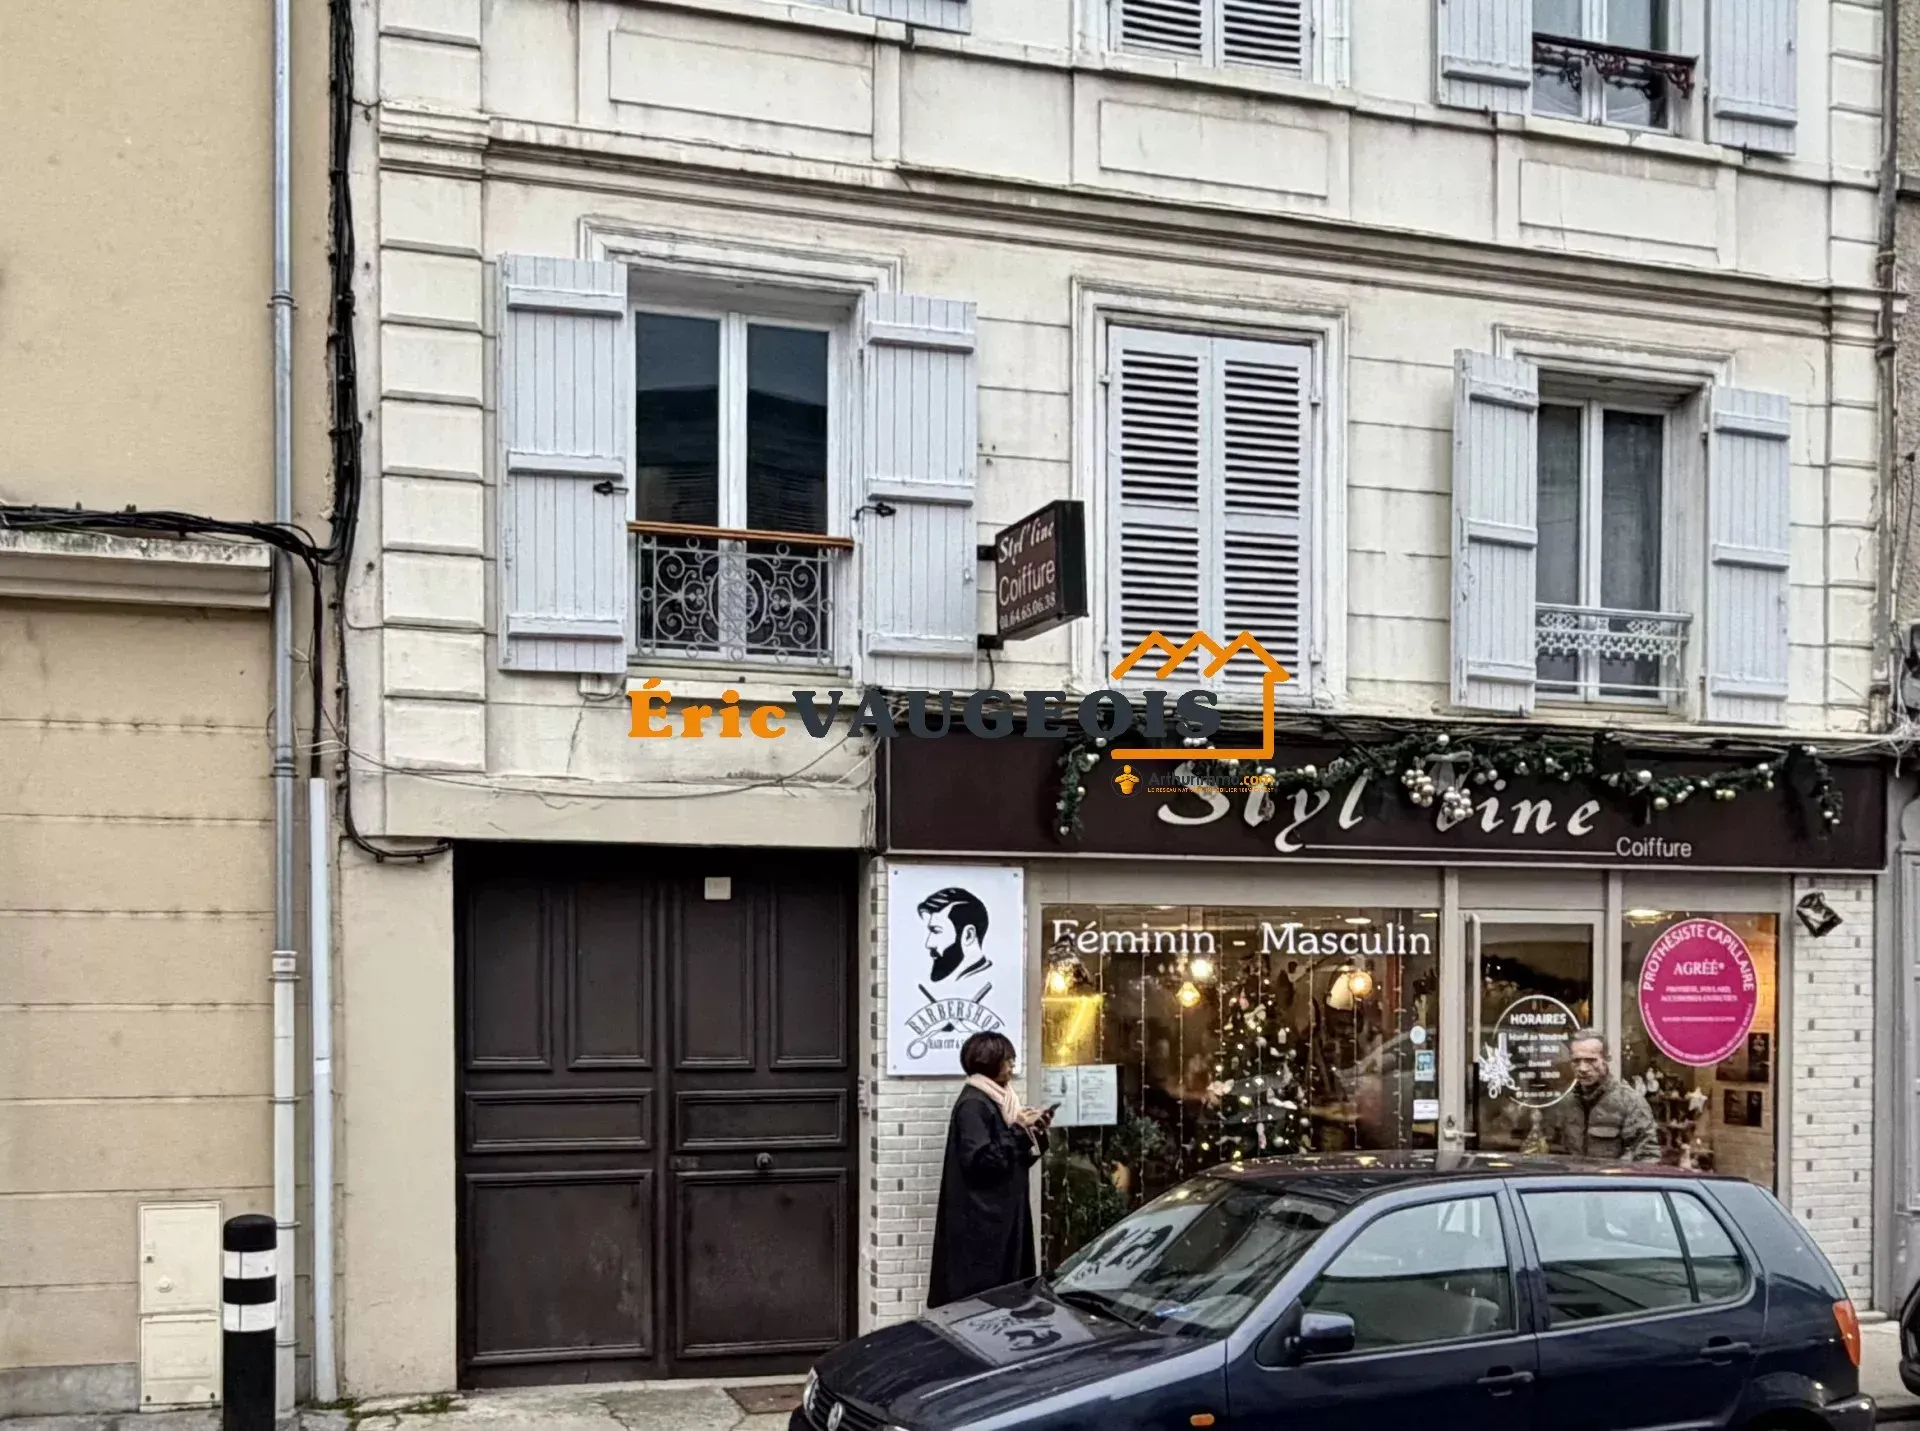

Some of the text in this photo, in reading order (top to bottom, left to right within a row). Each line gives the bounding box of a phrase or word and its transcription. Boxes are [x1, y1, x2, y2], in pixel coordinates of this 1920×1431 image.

[999, 559, 1055, 606] Coiffure
[1616, 836, 1692, 857] Coiffure
[1052, 919, 1216, 954] Féminin
[1260, 922, 1432, 954] Masculin
[1706, 926, 1755, 992] CAPILLAIRE
[907, 1000, 1001, 1035] BARBERSHOP
[1510, 1013, 1567, 1025] HORAIRES
